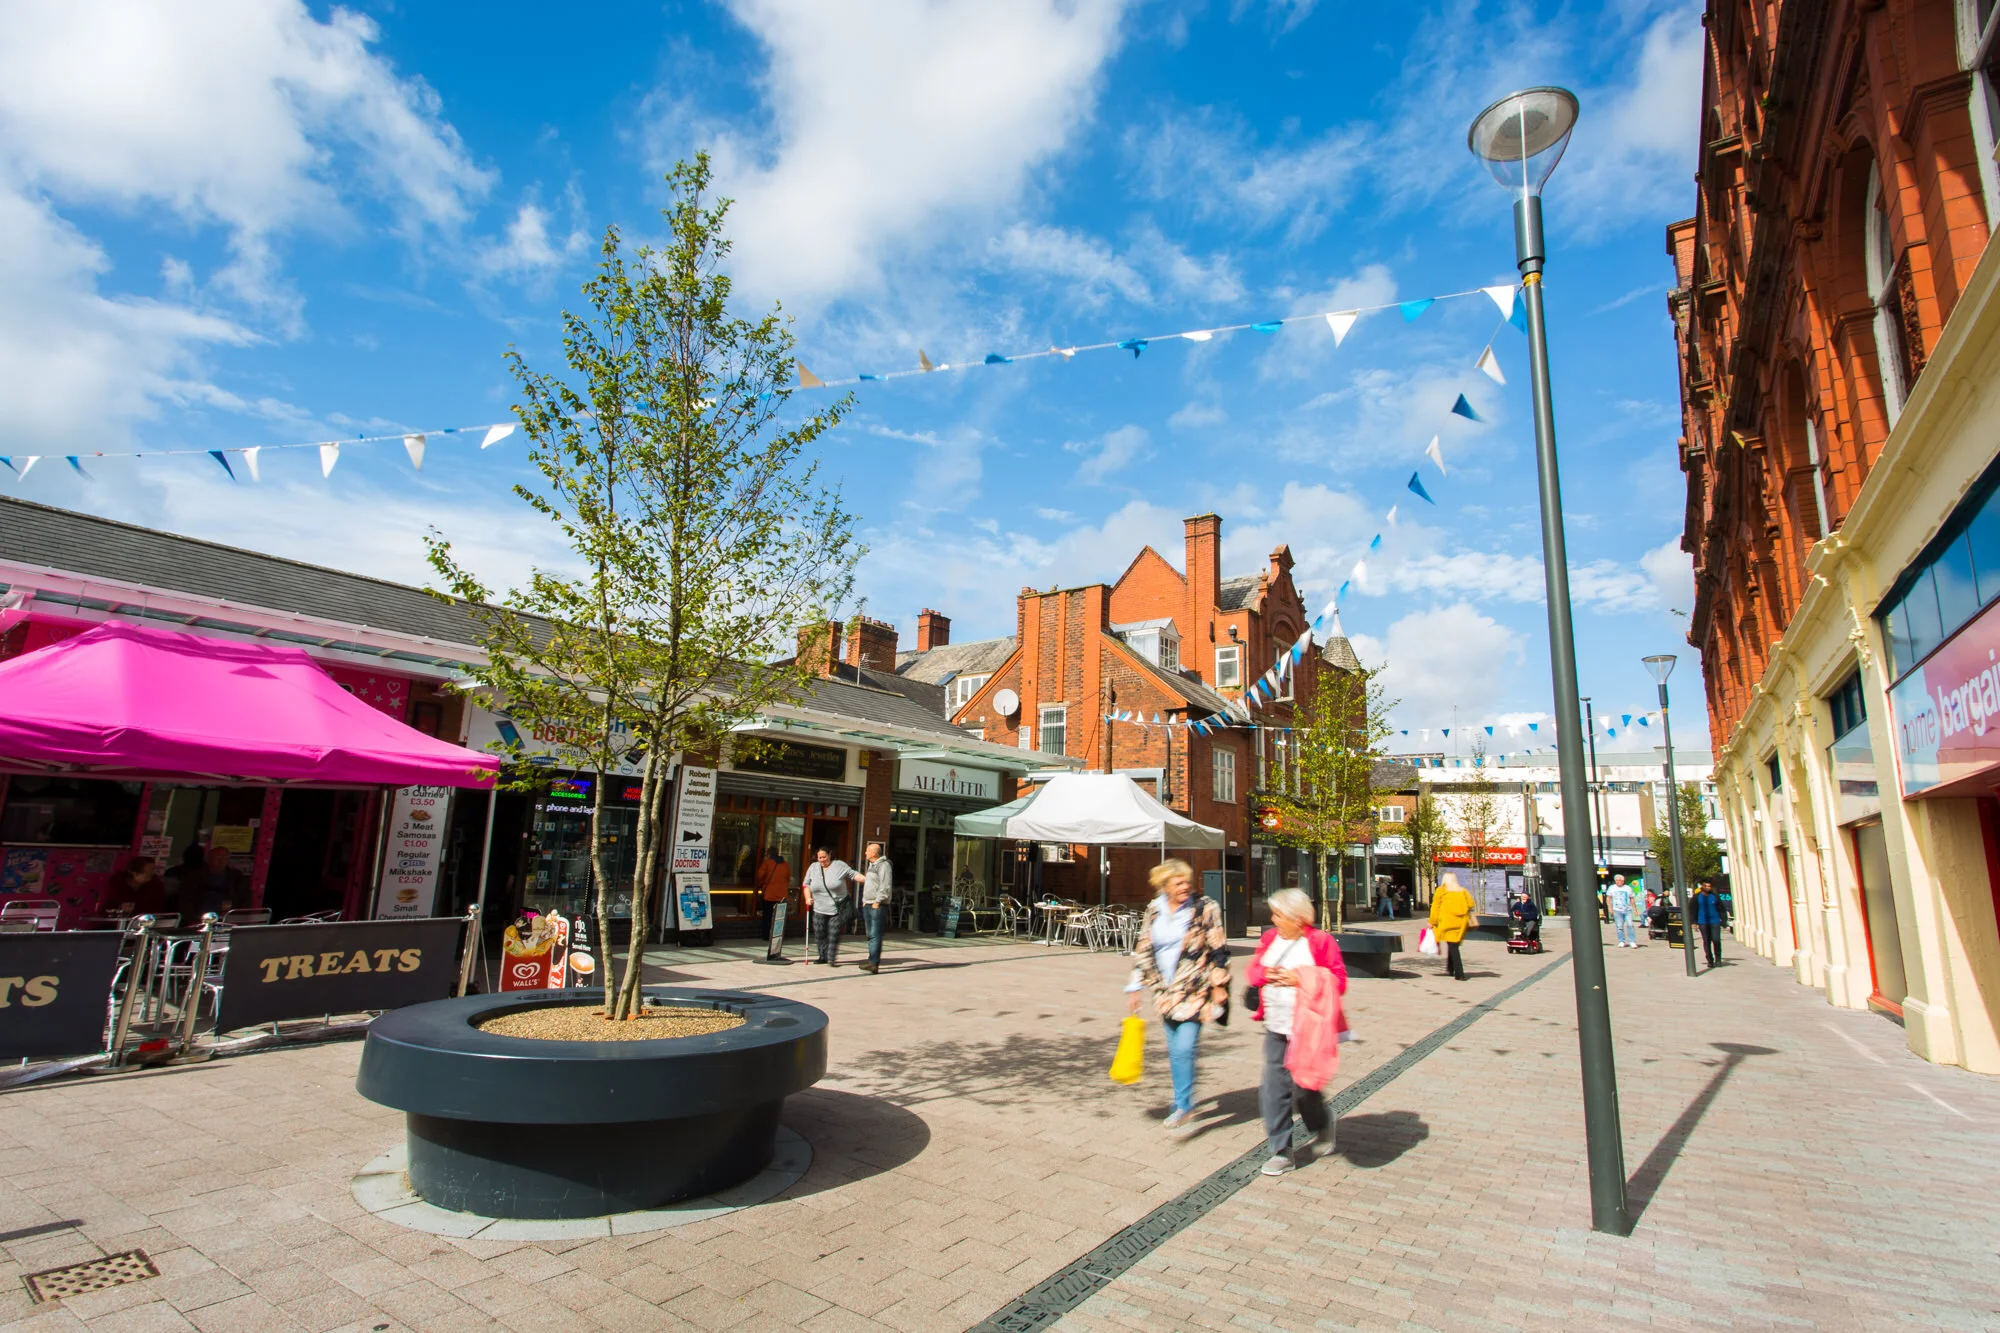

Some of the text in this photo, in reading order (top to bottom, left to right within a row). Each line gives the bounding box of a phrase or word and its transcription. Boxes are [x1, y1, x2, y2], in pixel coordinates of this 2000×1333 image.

[1937, 648, 2000, 738] bargai
[688, 769, 711, 779] Robert
[688, 779, 710, 788] James
[402, 788, 409, 797] 3
[550, 791, 587, 799] ACCESSORIES
[684, 788, 712, 797] Jeweller
[410, 798, 436, 807] £3.50
[545, 803, 569, 813] phone
[569, 805, 583, 814] and
[402, 822, 434, 831] 3 Meat
[396, 831, 437, 840] Samosas
[403, 840, 428, 848] £1.00
[396, 850, 431, 860] Regular
[676, 848, 707, 860] THE TECH
[674, 859, 700, 868] DOCTORS
[388, 868, 433, 877] Milkshake
[398, 876, 424, 884] £2.50
[259, 948, 422, 983] TREATS
[512, 979, 538, 988] WALL'S
